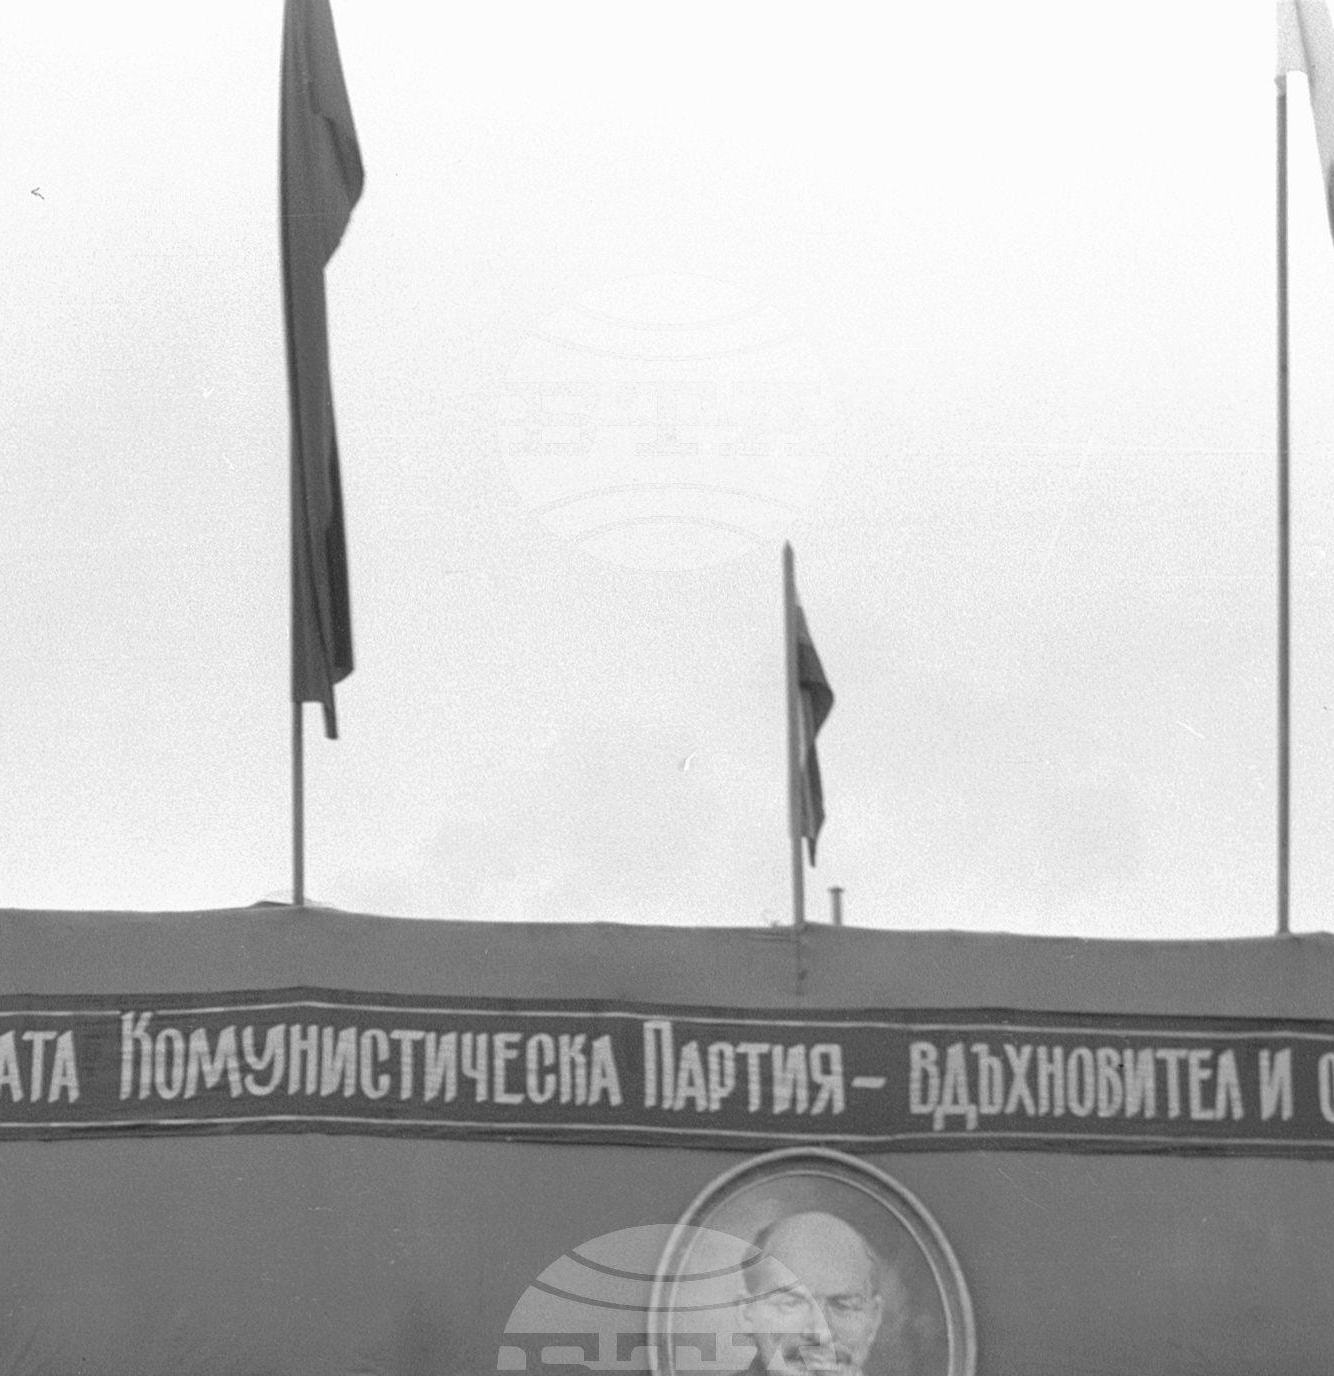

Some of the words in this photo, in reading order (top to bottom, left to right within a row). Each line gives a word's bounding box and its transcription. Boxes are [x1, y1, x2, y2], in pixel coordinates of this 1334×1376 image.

[118, 1012, 623, 1107] КОМУНИСТИЧЕСКА
[908, 1040, 1245, 1132] ВДЪХНОВИТЕЛ
[1258, 1047, 1294, 1122] И
